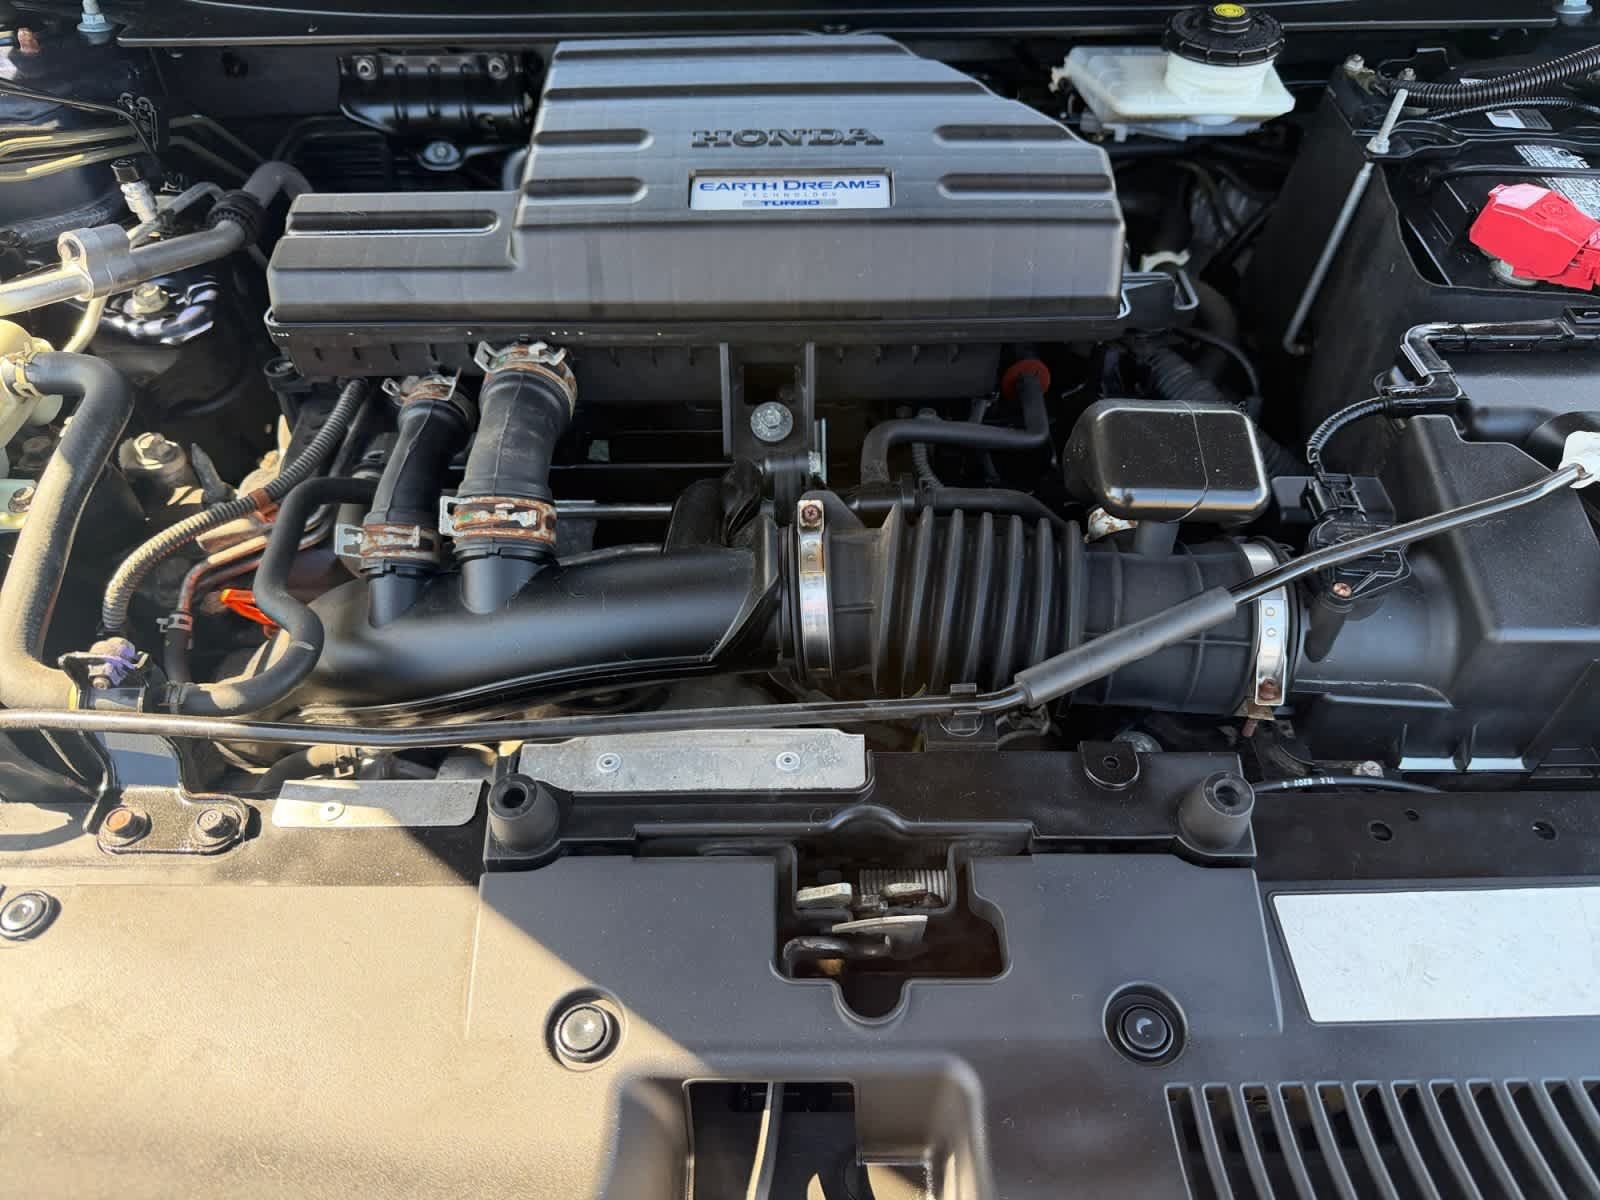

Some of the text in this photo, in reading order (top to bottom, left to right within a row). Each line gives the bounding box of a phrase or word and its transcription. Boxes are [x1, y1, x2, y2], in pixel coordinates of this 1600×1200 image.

[691, 128, 884, 148] HONDA
[700, 179, 881, 191] EARTH DREAMS
